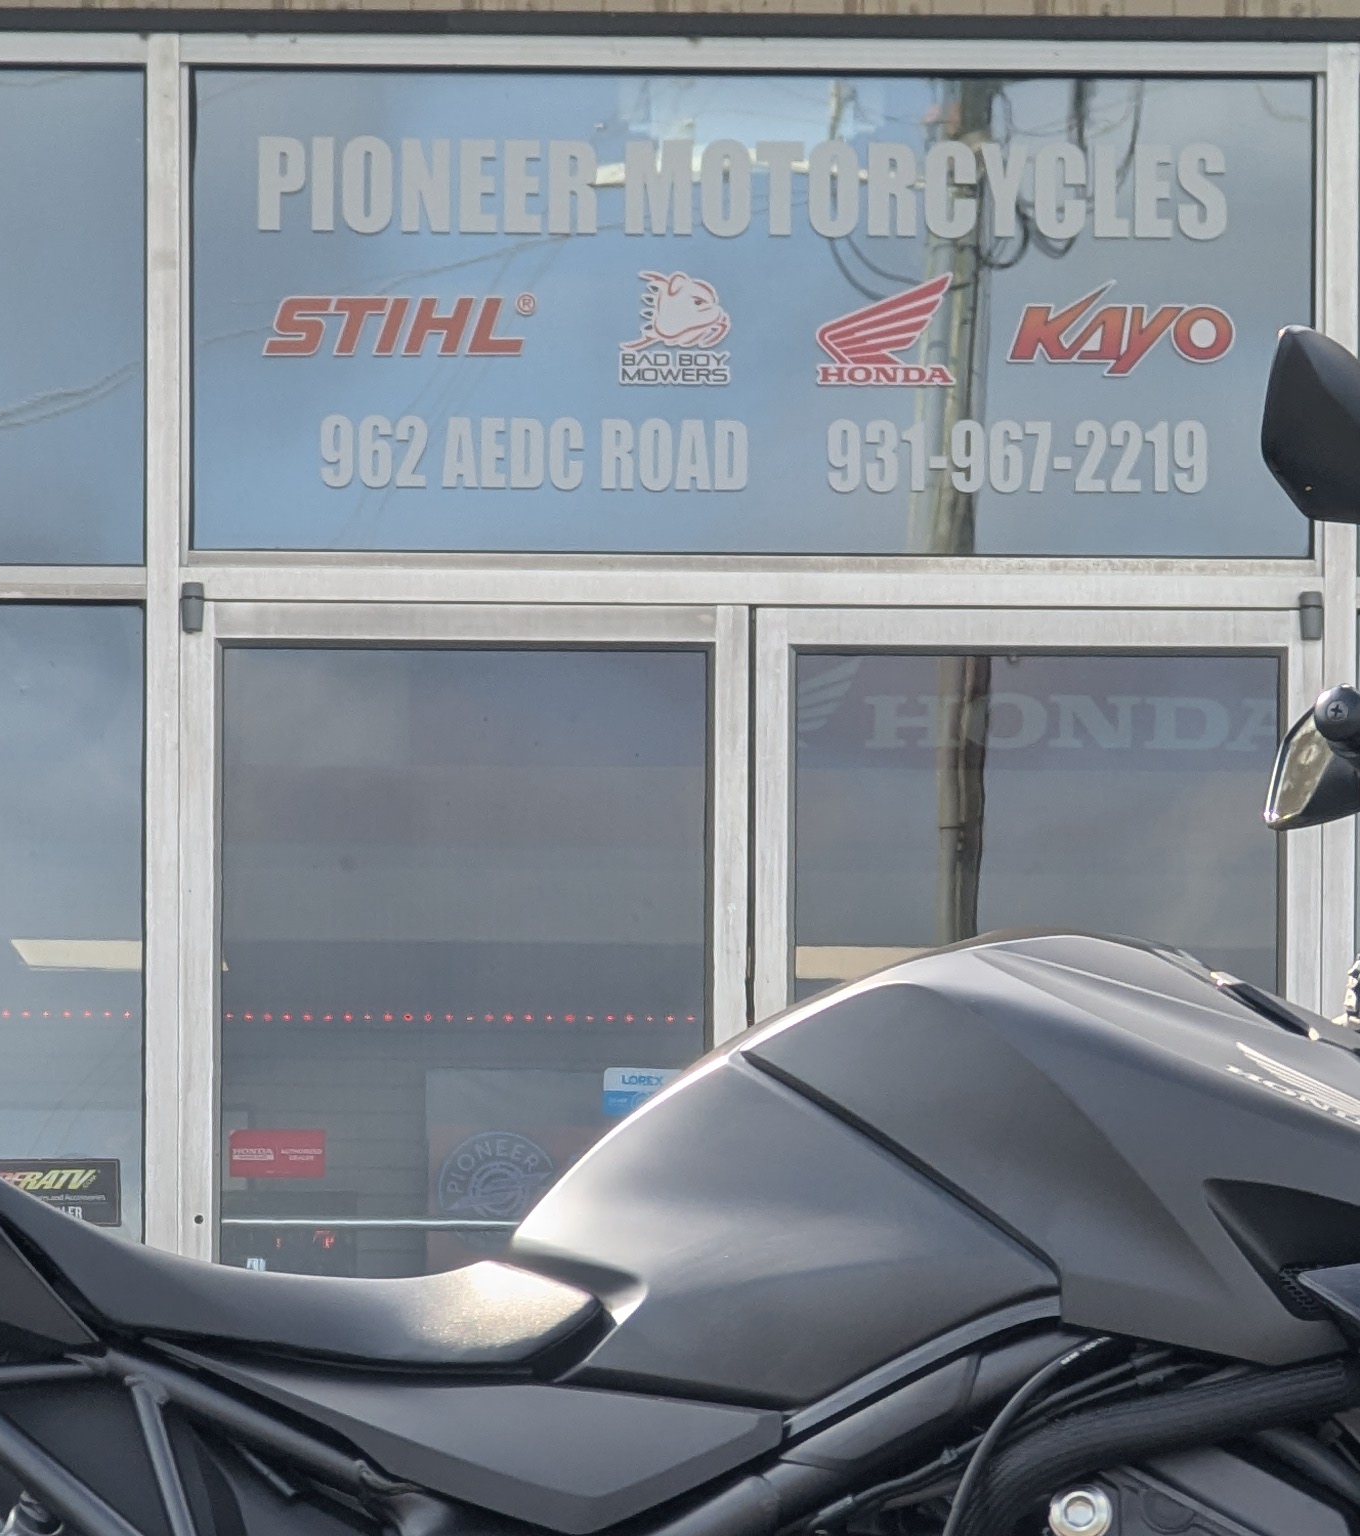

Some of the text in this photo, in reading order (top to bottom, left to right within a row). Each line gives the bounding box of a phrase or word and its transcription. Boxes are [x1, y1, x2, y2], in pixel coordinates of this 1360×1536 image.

[257, 134, 1228, 241] PIONEER MOTORCYCLES
[262, 296, 526, 356] STIHL
[1007, 279, 1236, 377] KAYO
[621, 352, 728, 367] BAD BOY
[621, 367, 728, 383] MOWERS
[819, 366, 953, 384] HONDA
[320, 414, 749, 491] 962 AEDC ROAD
[826, 418, 1209, 494] 931-967-2219
[621, 1074, 664, 1086] LOREX
[446, 1138, 539, 1193] PIONEER
